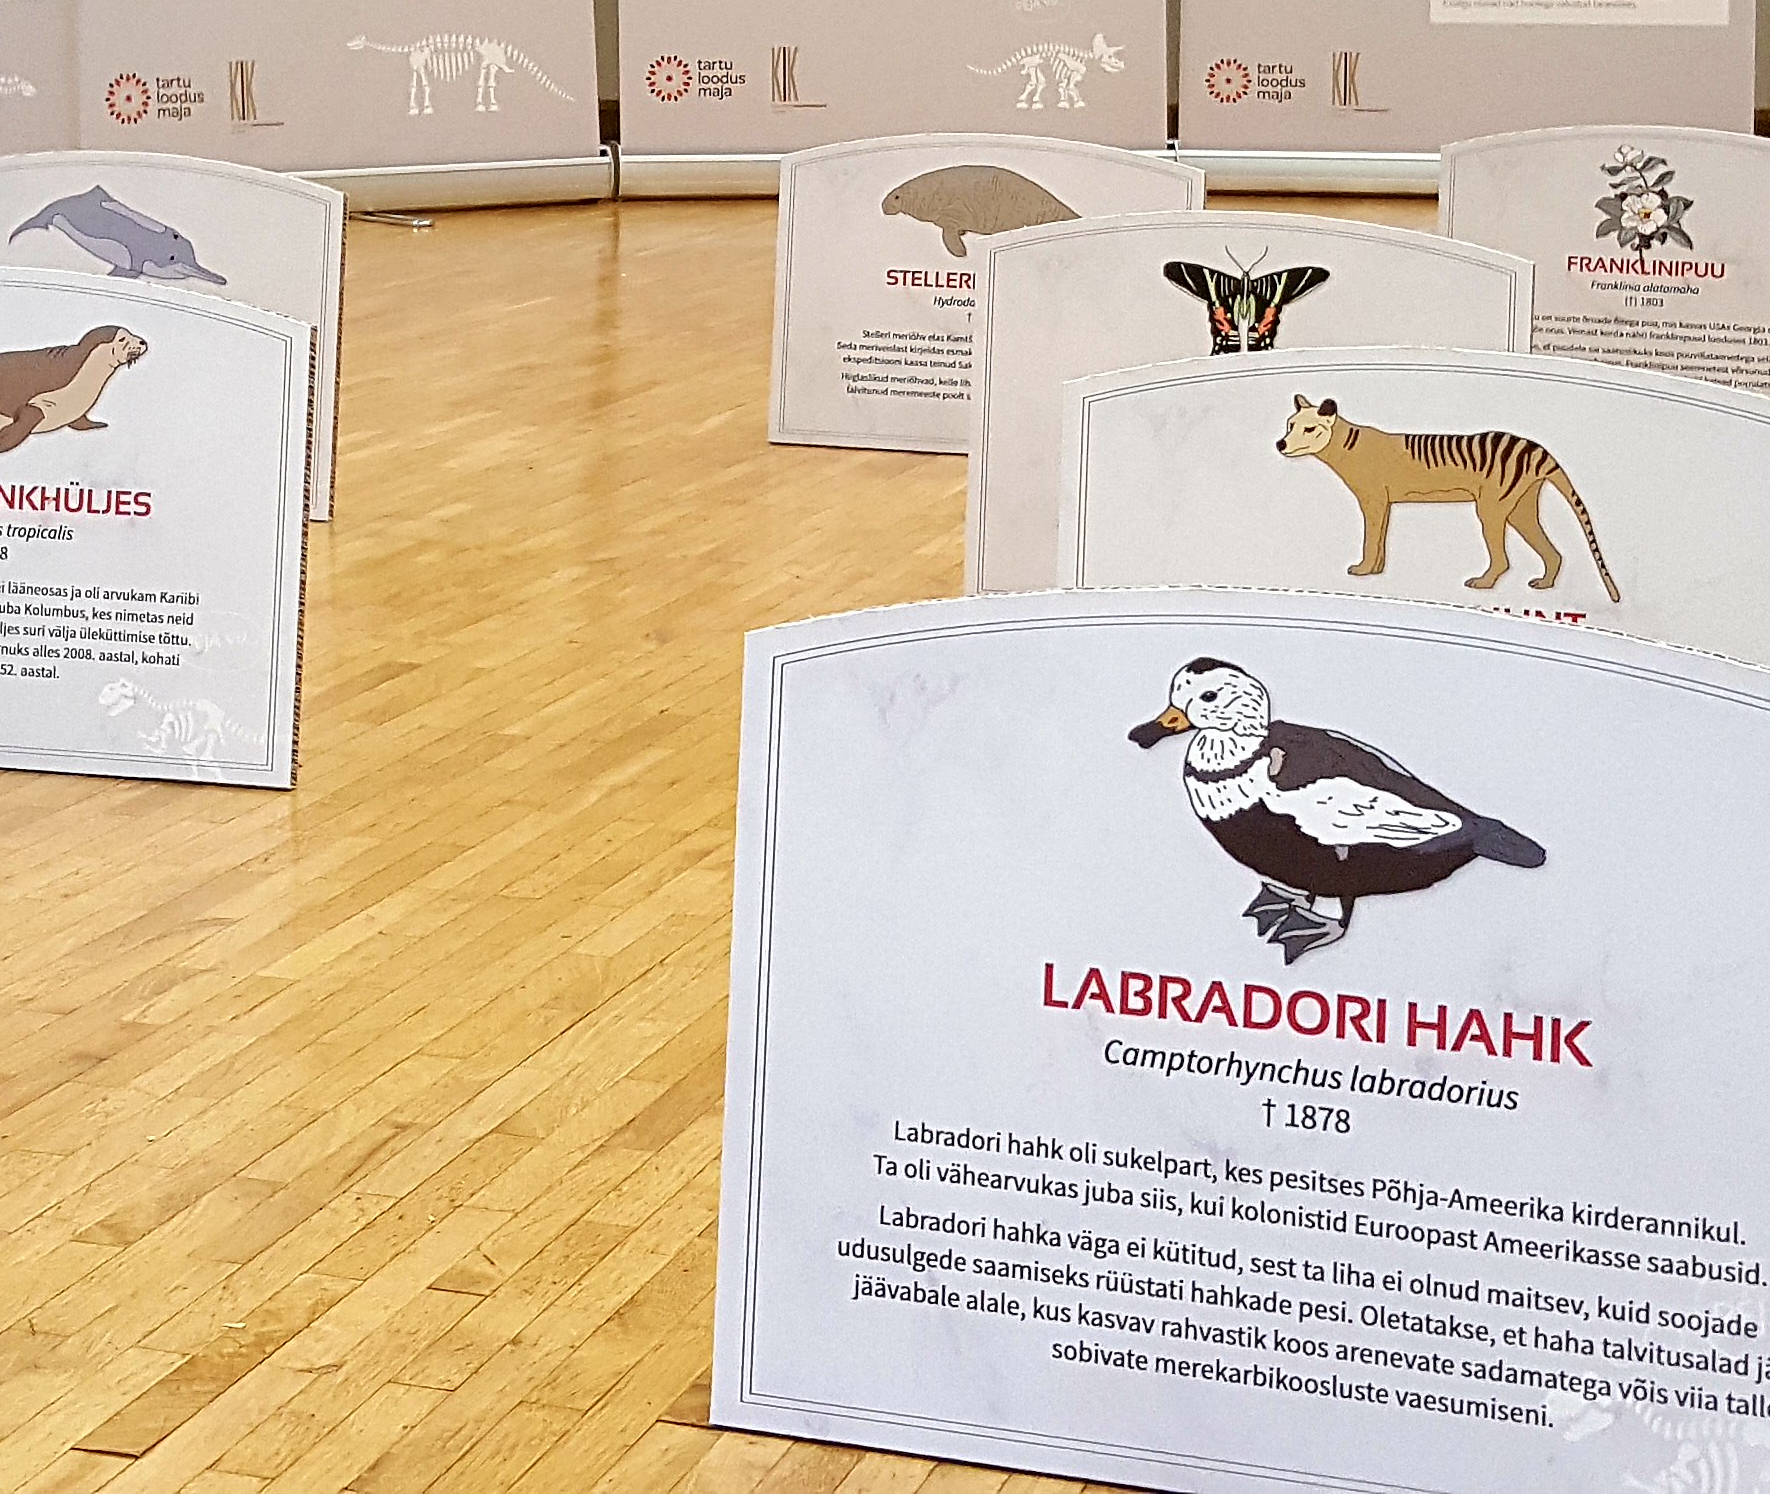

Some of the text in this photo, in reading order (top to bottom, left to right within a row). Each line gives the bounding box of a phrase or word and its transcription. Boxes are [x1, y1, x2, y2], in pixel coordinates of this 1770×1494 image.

[696, 59, 734, 71] tartu
[1256, 62, 1294, 75] tartu
[155, 75, 192, 93] tartu
[697, 73, 747, 86] loodus
[1257, 76, 1307, 90] loodus
[156, 91, 205, 106] loodus
[697, 87, 733, 99] maja
[1256, 90, 1292, 104] maja
[157, 106, 192, 122] maja
[1567, 254, 1726, 279] FRANKLINIPUU
[6, 523, 75, 543] tropicalis
[7, 580, 69, 598] lääneosas
[69, 584, 82, 602] ja
[84, 586, 101, 600] oli
[102, 588, 157, 604] arvukam
[159, 591, 200, 606] Kariibi
[1043, 962, 1594, 1068] LABRADORI HAHK
[1103, 1038, 1520, 1111] Camptorhynchus labradorius
[1284, 1102, 1351, 1135] 1878
[894, 1119, 1747, 1246] Labradori hahk oli sukelpart, kes pesitses Põhja-Ameerika kirderannikul.
[872, 1153, 1768, 1288] Ta oli vähearvukas juba siis, kui kolonistid Euroopast Ameerikasse saabusid.
